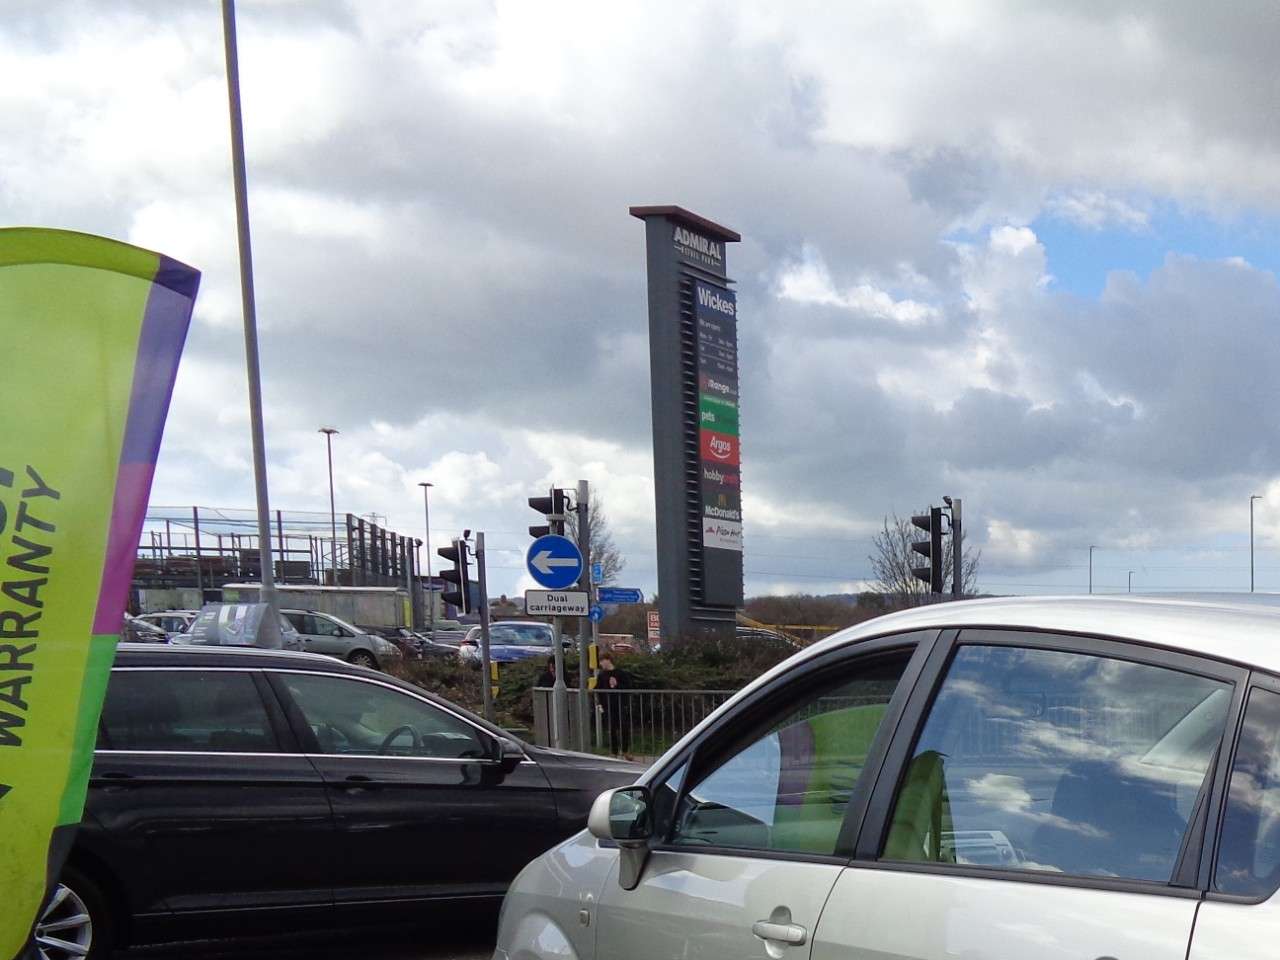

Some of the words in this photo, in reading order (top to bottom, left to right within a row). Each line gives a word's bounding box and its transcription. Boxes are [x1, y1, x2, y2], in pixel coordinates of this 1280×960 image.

[674, 226, 722, 260] ADMIRAL
[697, 286, 735, 315] Wickes
[710, 436, 732, 453] Argos
[0, 464, 61, 748] WARRANTY
[529, 605, 585, 614] carriageway
[547, 594, 568, 603] Dual
